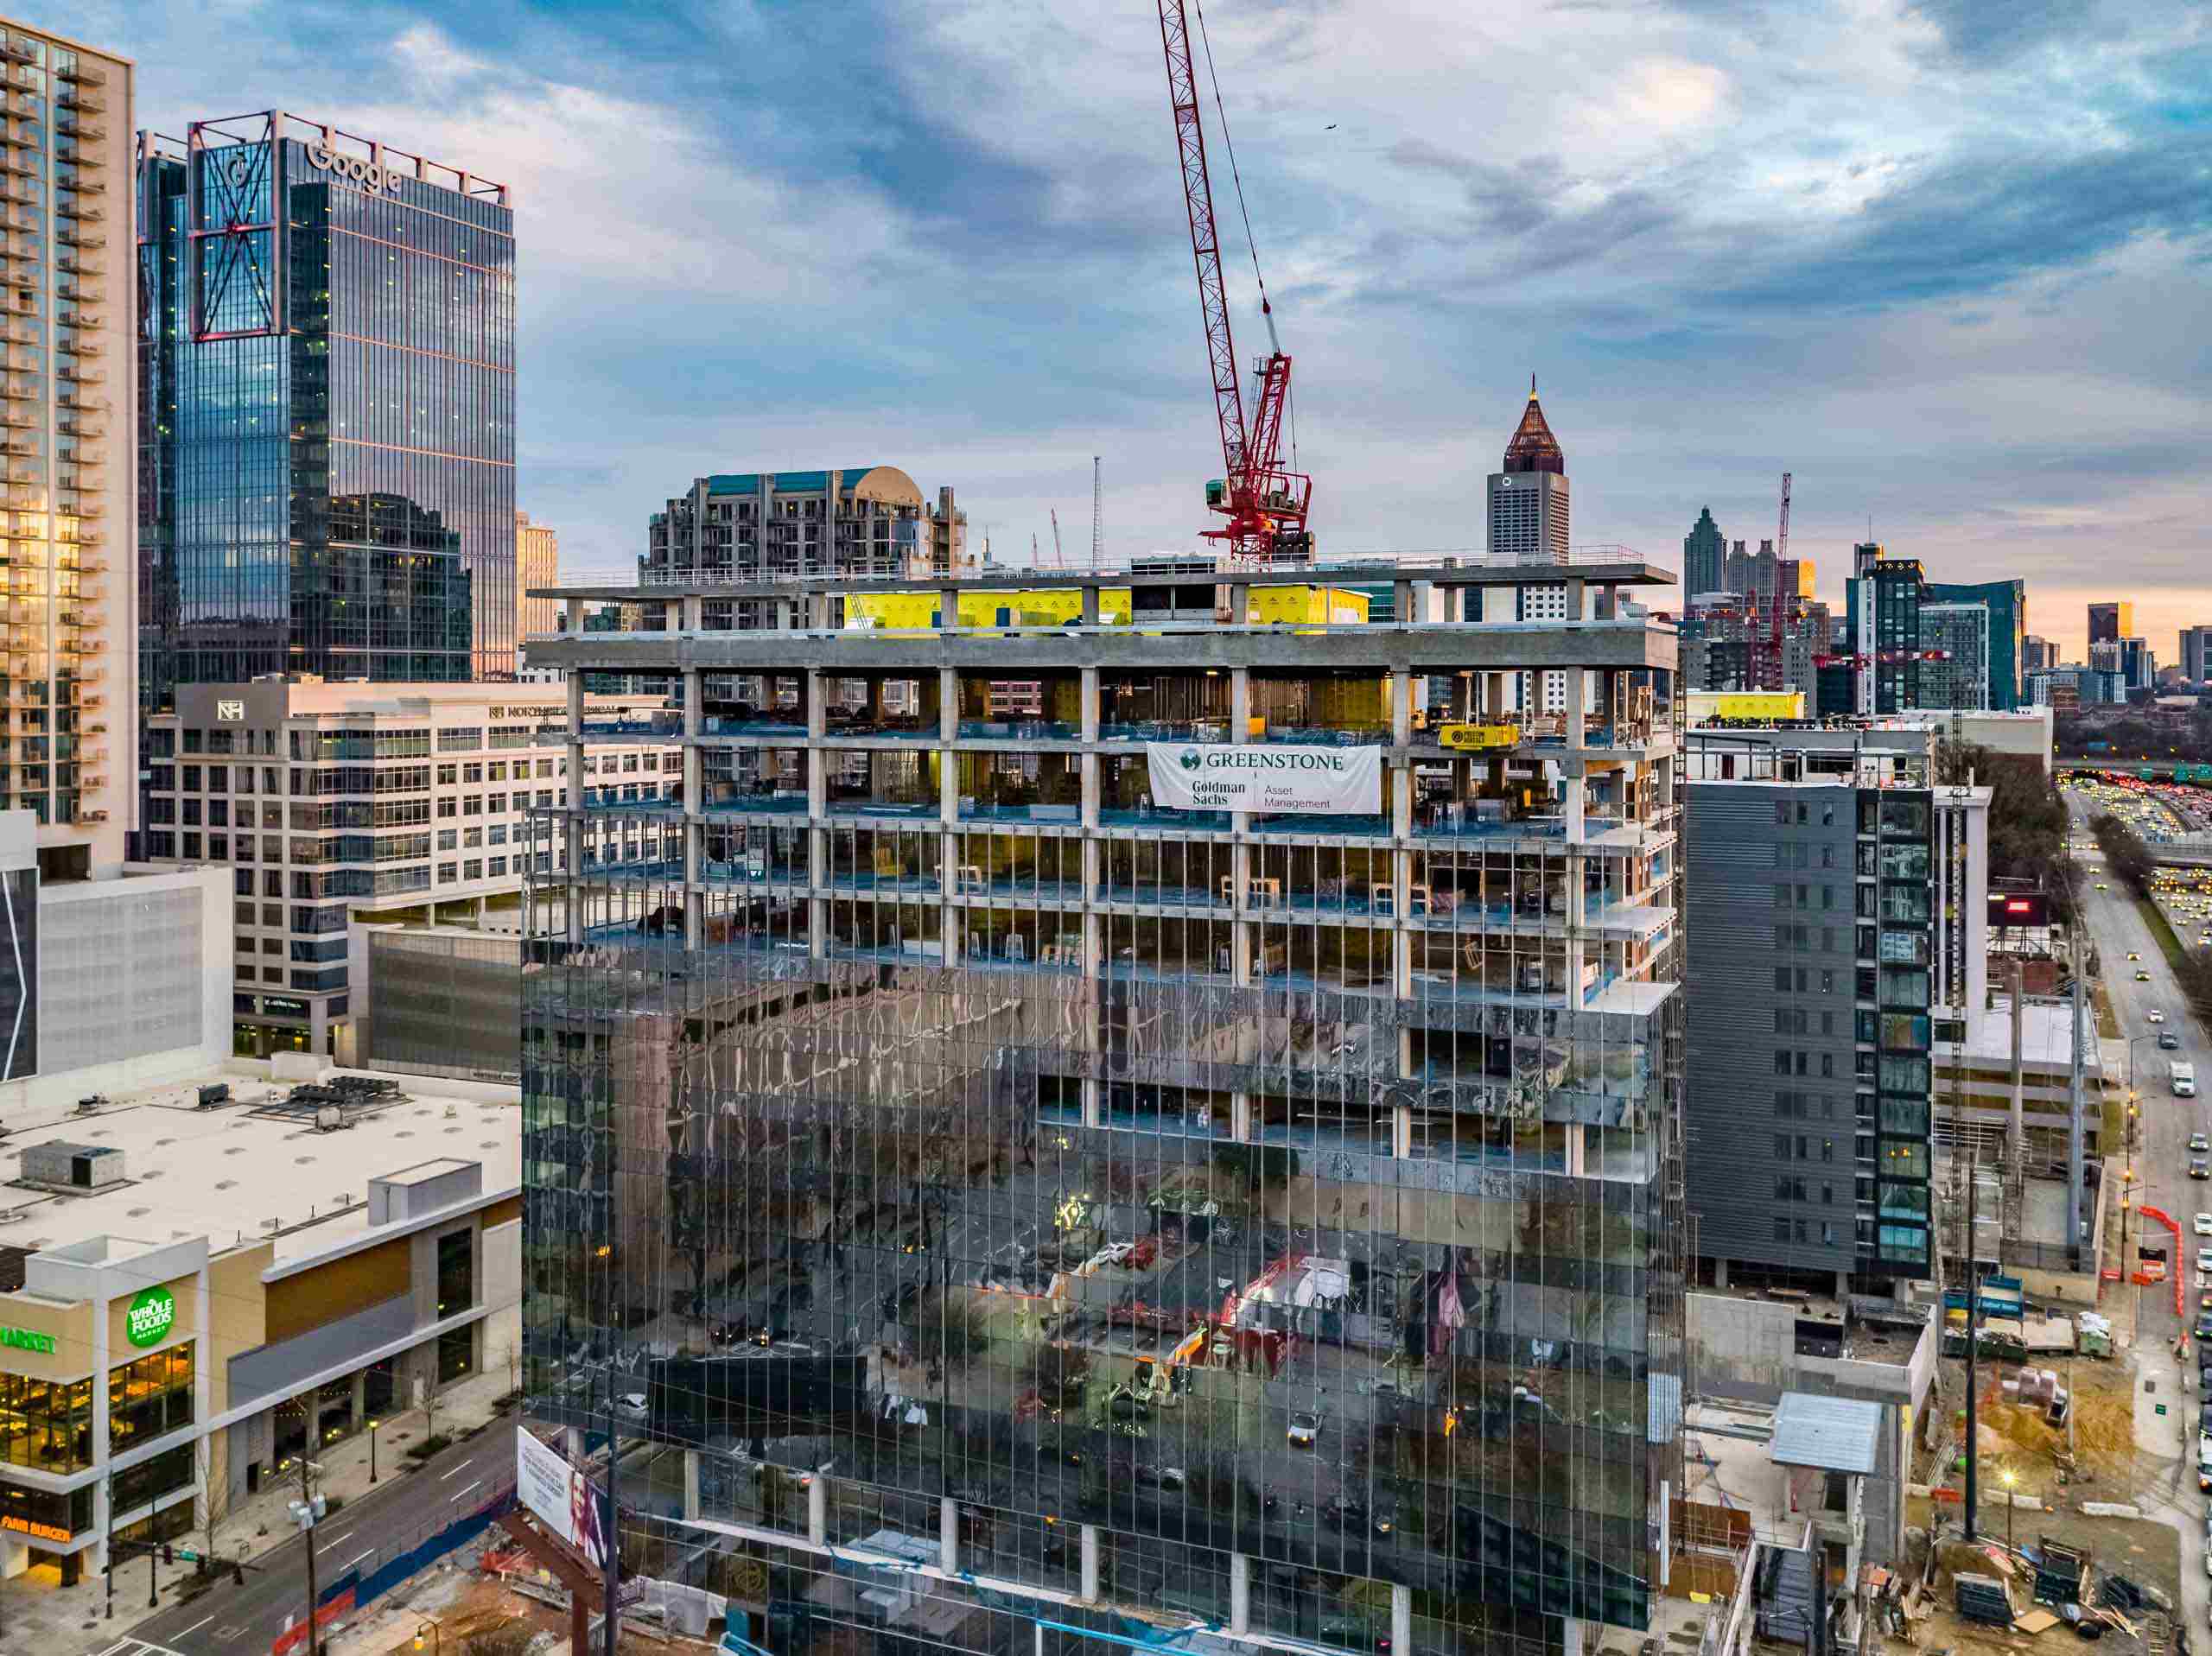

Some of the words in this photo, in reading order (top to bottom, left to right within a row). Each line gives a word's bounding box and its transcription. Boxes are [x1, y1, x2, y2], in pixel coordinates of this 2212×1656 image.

[305, 137, 402, 195] Google
[1206, 753, 1344, 771] GREENSTONE
[1192, 780, 1245, 794] Goldman
[1264, 785, 1294, 796] Asset
[1192, 794, 1228, 805] Sachs
[1264, 797, 1331, 809] Management
[130, 1298, 173, 1322] WHOLE
[131, 1310, 172, 1334] FOODS
